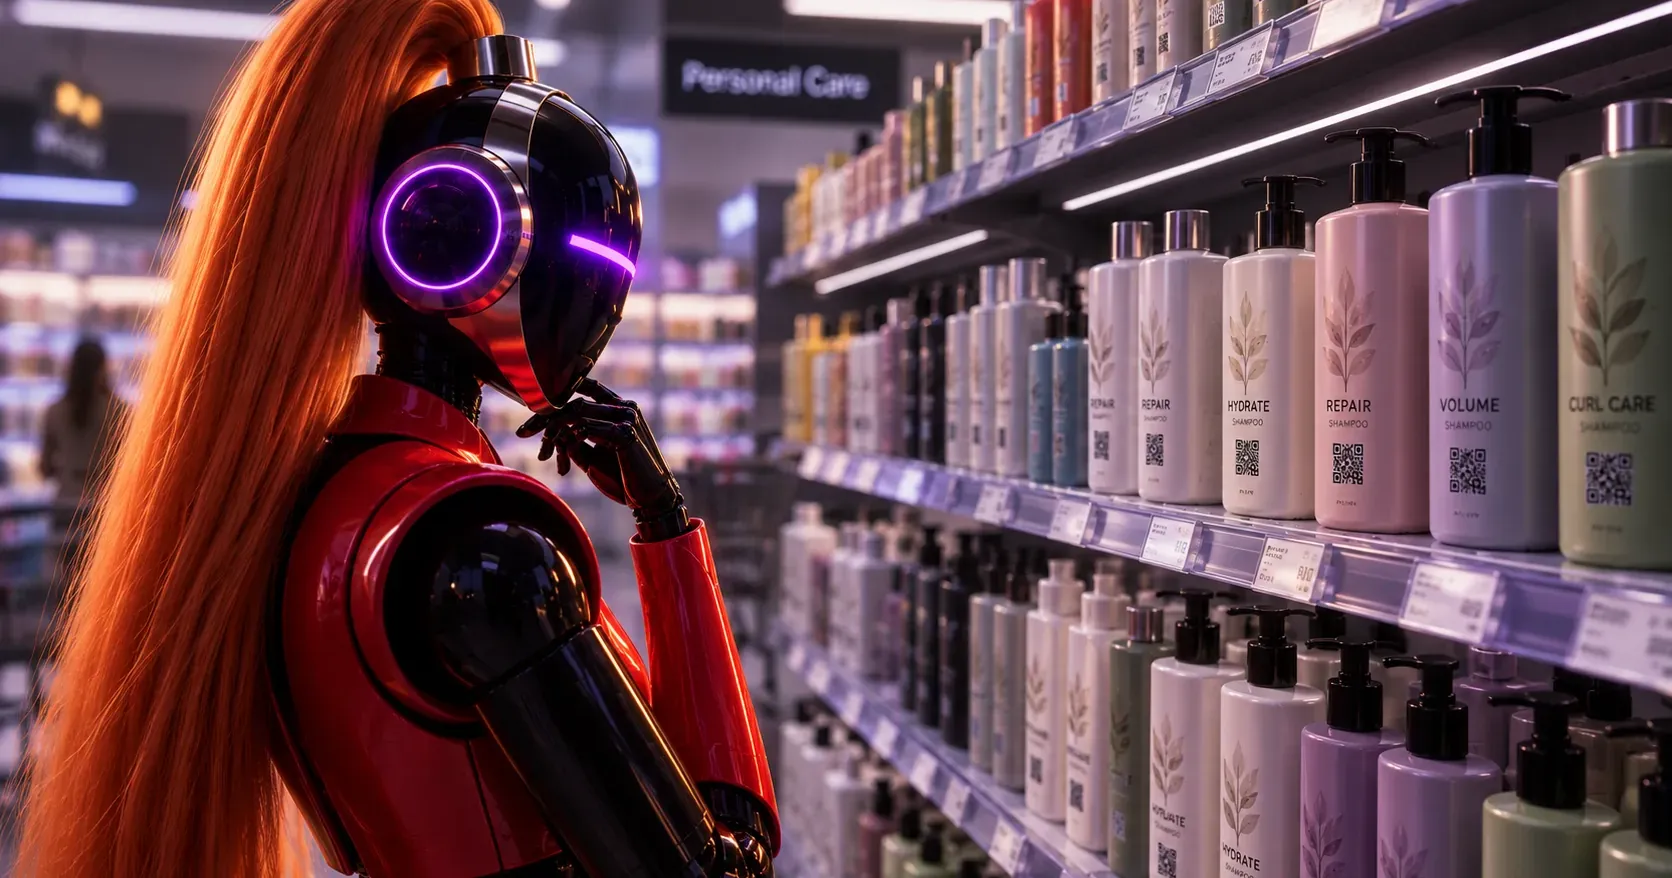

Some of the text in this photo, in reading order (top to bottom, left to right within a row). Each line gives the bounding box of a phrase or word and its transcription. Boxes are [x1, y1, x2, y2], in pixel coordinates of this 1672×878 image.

[682, 59, 870, 100] Personal Care
[1142, 399, 1171, 410] REPAIR
[1227, 400, 1271, 413] HYDRATE
[1326, 399, 1372, 413] REPAIR
[1439, 398, 1500, 413] VOLUME
[1568, 396, 1656, 413] CURL CARE
[1232, 417, 1264, 427] SHAMPOO
[1328, 419, 1369, 429] SHAMPOO
[1444, 420, 1492, 432] SHAMPOO
[1580, 421, 1641, 434] SHAMPOO
[1222, 842, 1261, 872] HYDRATE
